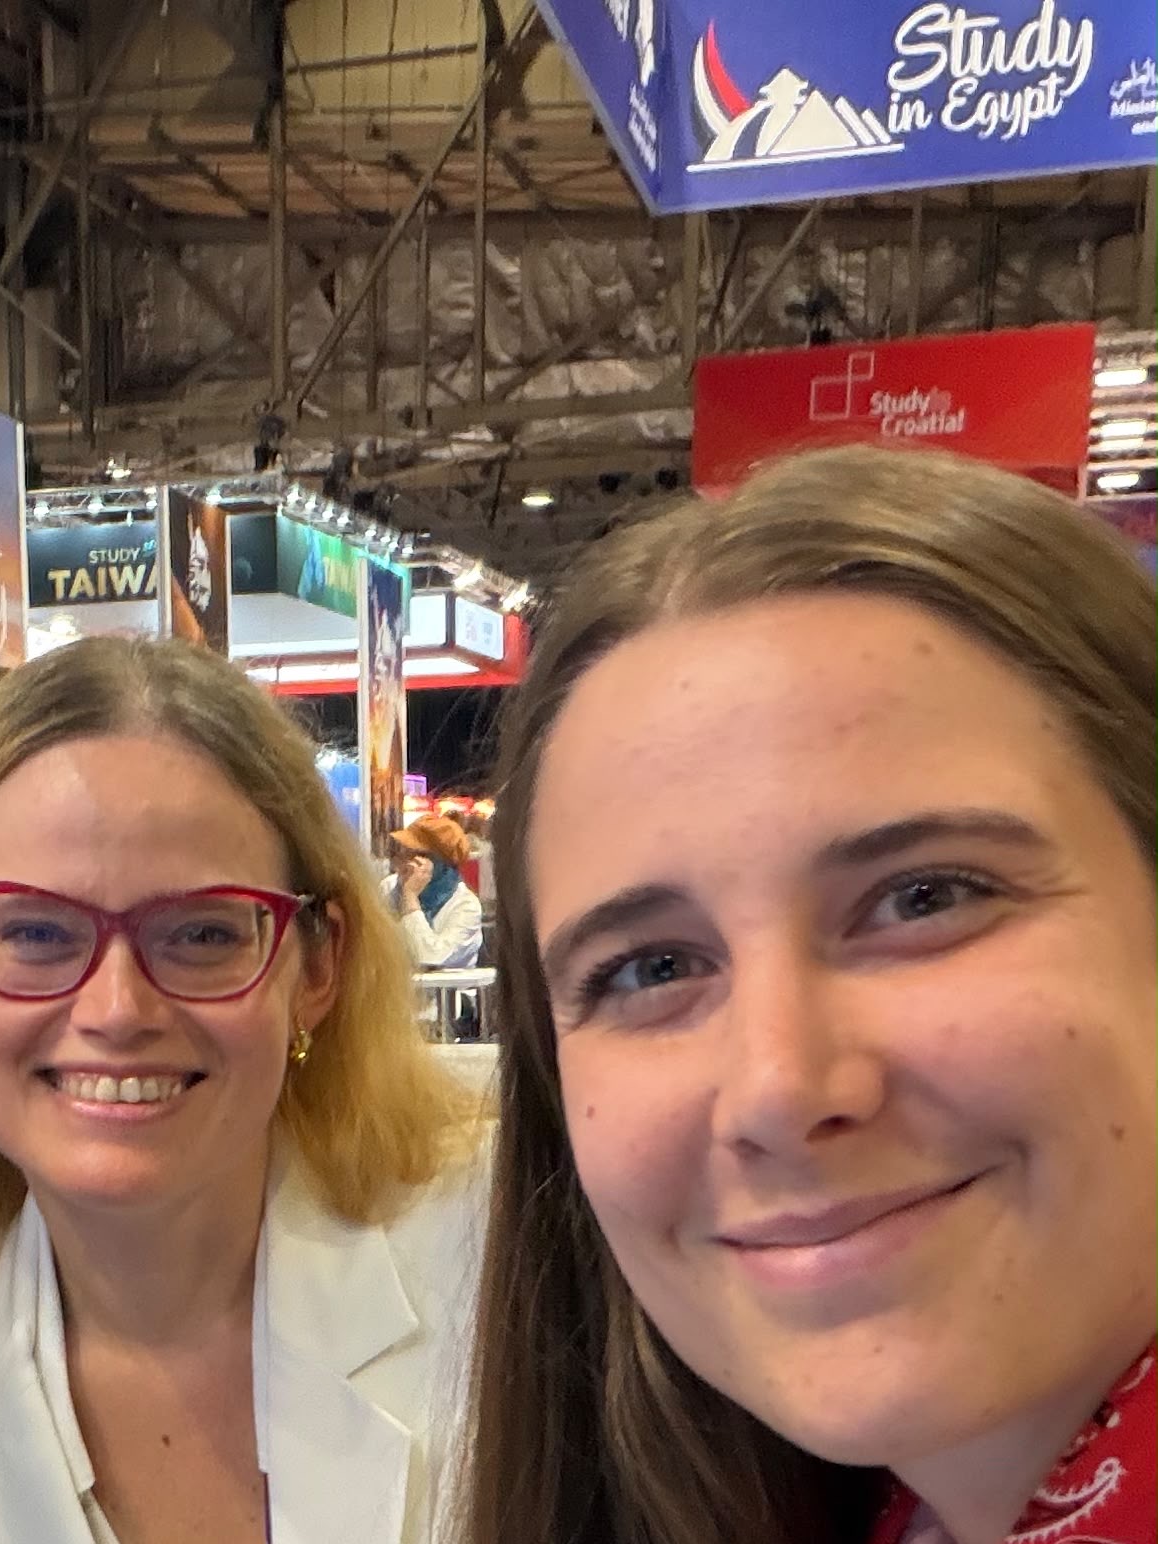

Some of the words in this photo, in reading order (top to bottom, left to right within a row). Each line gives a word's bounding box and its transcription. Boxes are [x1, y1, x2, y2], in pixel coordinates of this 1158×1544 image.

[888, 0, 1094, 97] Study
[888, 92, 933, 134] in
[941, 76, 1068, 141] Egypt
[868, 386, 931, 417] Study
[88, 546, 142, 565] STUDY
